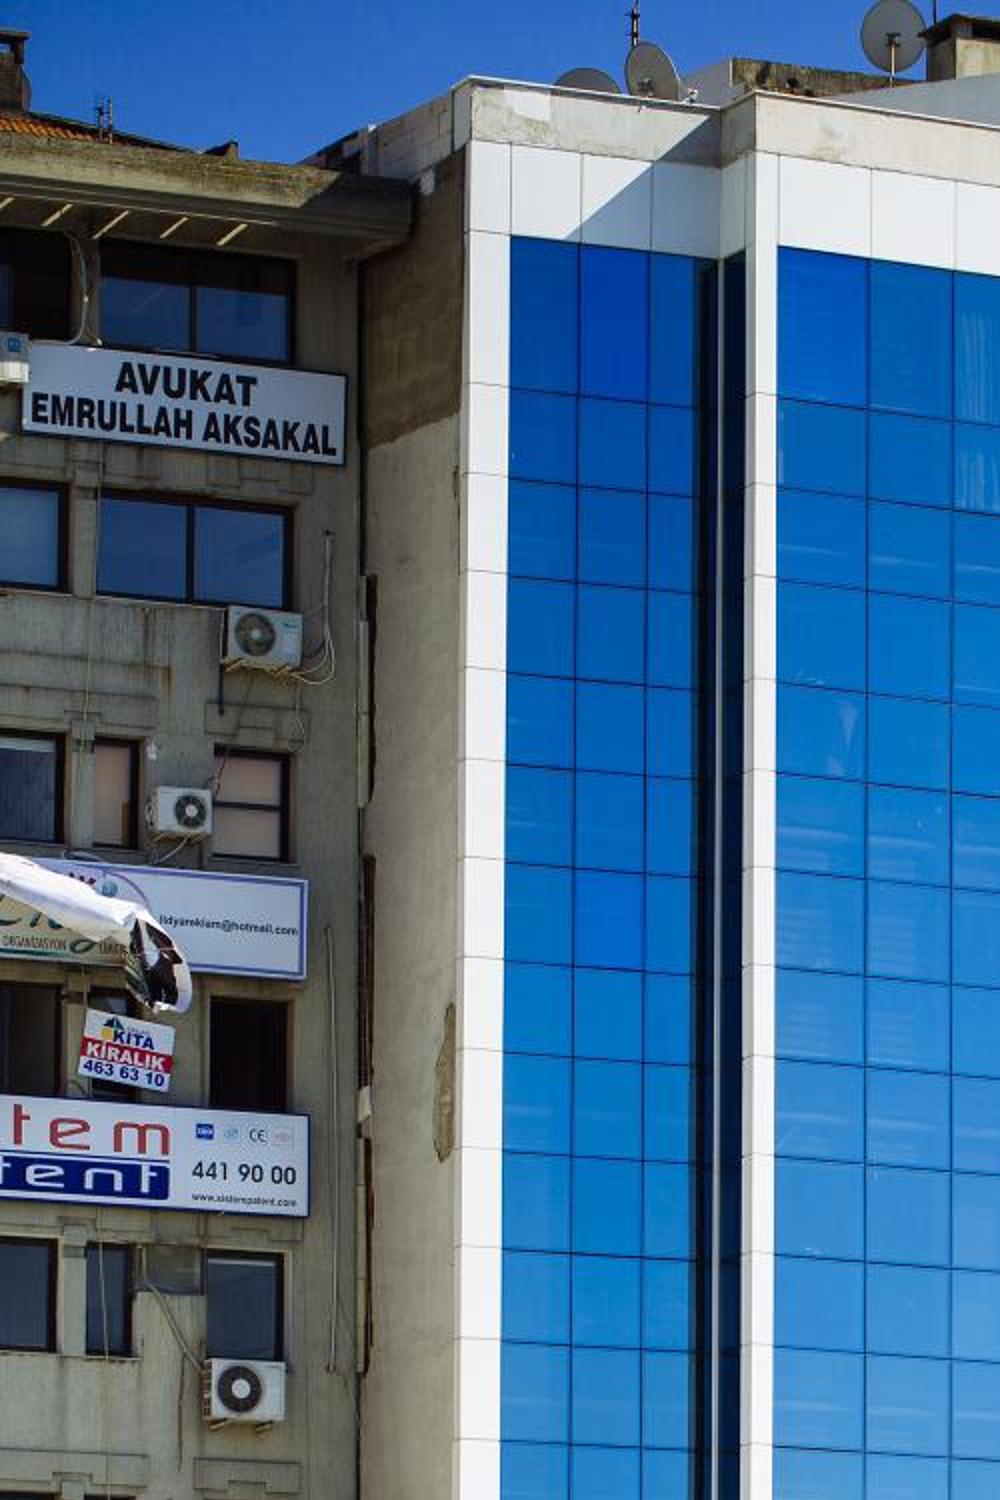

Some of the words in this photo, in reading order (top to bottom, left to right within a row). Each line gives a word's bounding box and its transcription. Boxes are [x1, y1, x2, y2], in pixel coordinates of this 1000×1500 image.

[115, 361, 258, 407] AVUKAT
[31, 392, 193, 440] EMRULLAH
[202, 411, 337, 457] AKSAKAL
[83, 1059, 114, 1077] 463
[119, 1066, 139, 1081] 63
[145, 1072, 165, 1087] 10
[192, 1160, 228, 1181] 441
[238, 1163, 264, 1183] 90
[271, 1165, 297, 1185] 00
